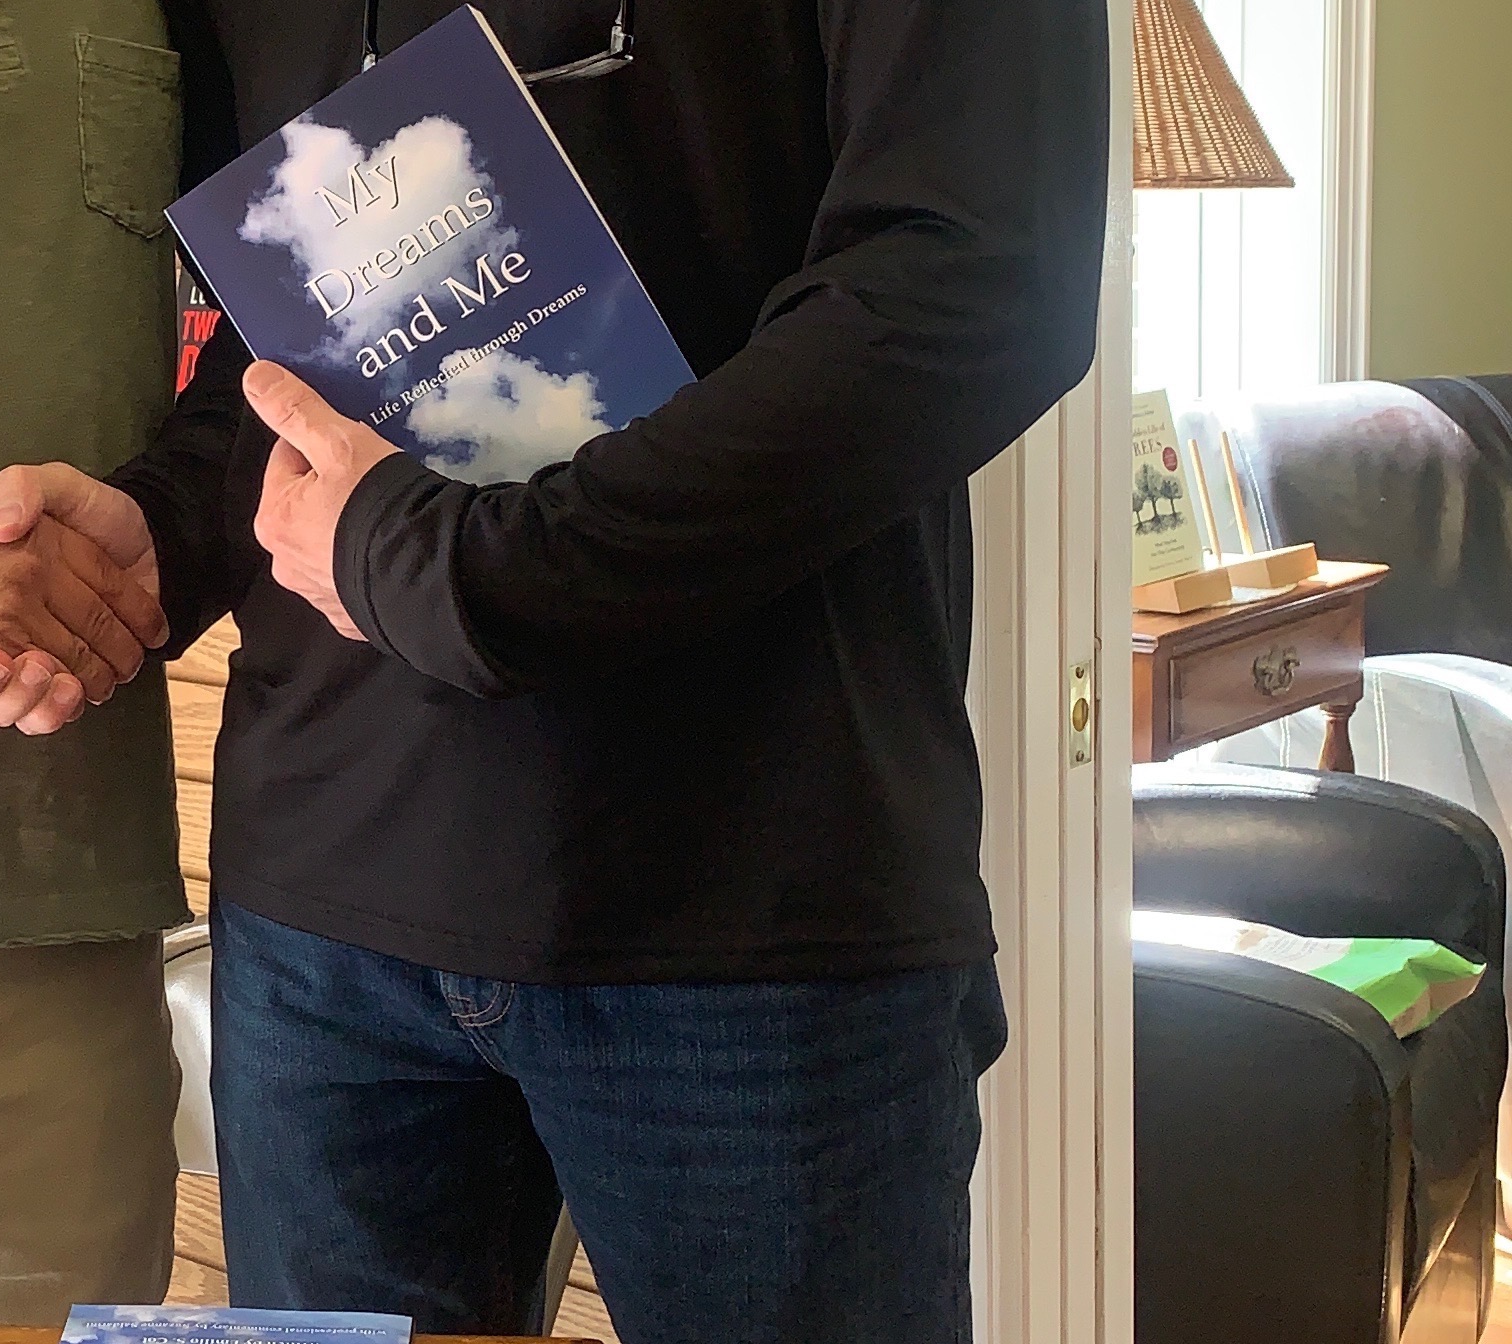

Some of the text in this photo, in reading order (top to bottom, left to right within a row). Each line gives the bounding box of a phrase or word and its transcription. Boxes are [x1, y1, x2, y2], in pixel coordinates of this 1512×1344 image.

[314, 155, 402, 228] My
[304, 182, 496, 320] Dreams
[353, 250, 533, 380] and Me
[369, 282, 589, 427] Life Reflected through Dreams
[192, 1321, 209, 1331] by
[211, 1322, 282, 1333] commentary
[285, 1325, 356, 1336] professional
[360, 1327, 387, 1336] with
